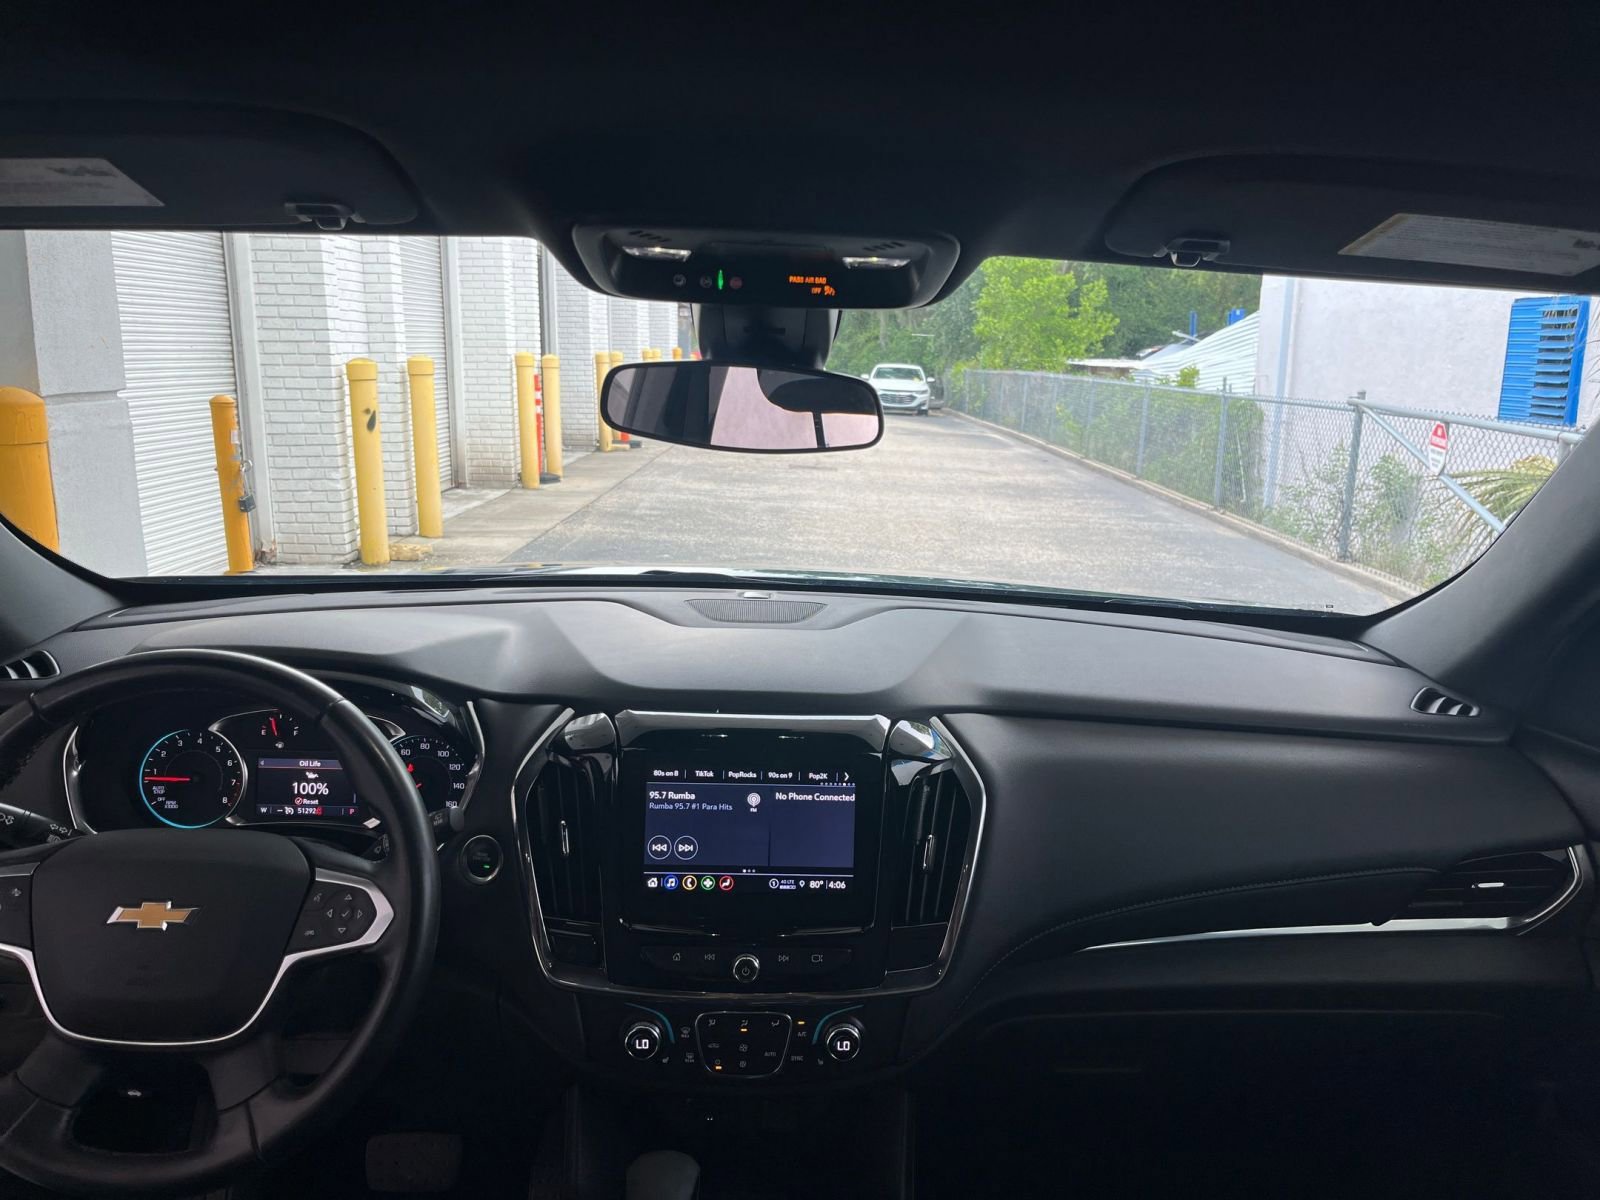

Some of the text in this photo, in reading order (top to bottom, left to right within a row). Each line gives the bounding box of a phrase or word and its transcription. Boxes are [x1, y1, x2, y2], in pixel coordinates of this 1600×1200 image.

[177, 739, 183, 747] 3
[161, 750, 167, 758] 2
[448, 763, 461, 771] 120
[728, 771, 757, 780] PopRocks
[292, 782, 329, 795] 100%
[453, 782, 465, 790] 140
[222, 796, 228, 804] 8
[649, 791, 696, 800] 95.7 Rumba
[775, 792, 856, 802] No Phone Connected
[649, 802, 674, 810] Rumba
[702, 803, 718, 811] Para
[718, 803, 733, 811] Hits
[828, 880, 846, 890] 4:06
[636, 1039, 649, 1049] LO
[837, 1040, 850, 1051] LO
